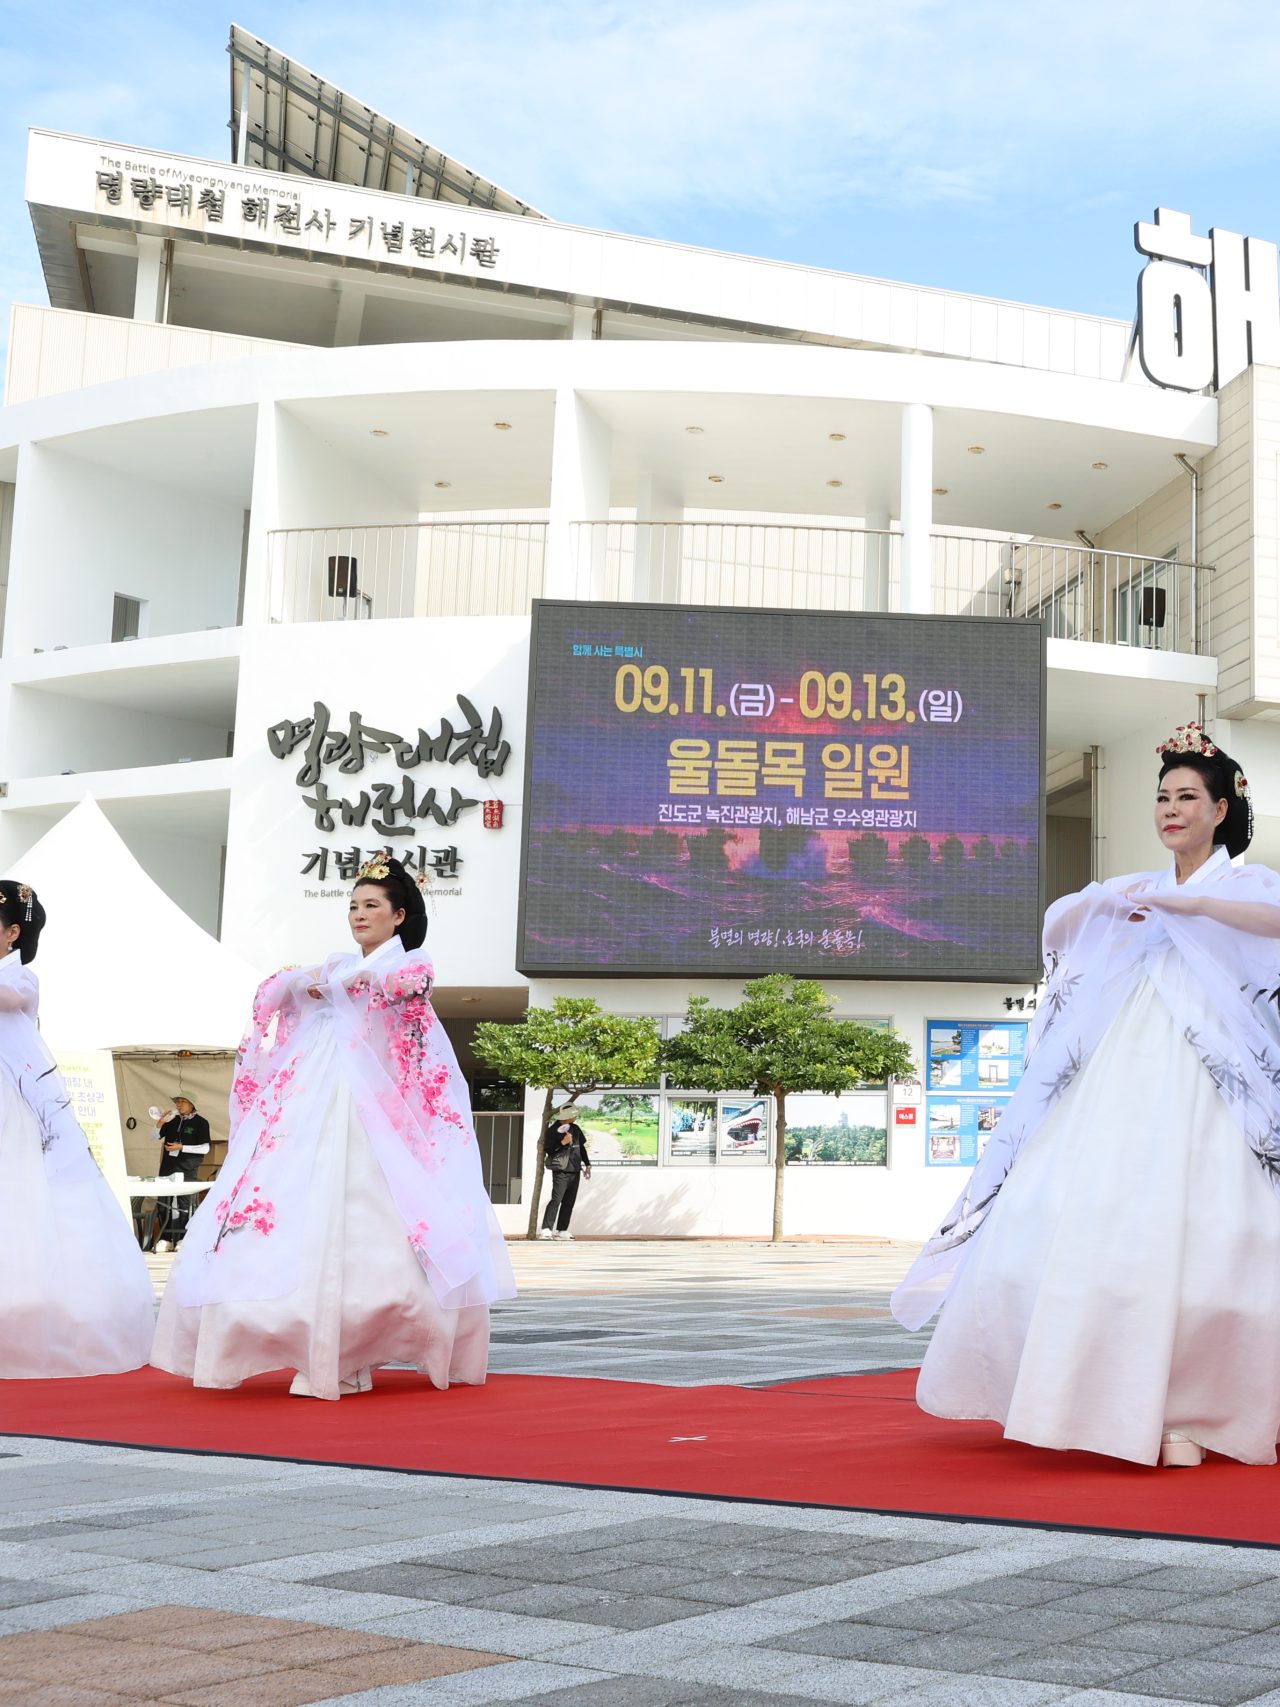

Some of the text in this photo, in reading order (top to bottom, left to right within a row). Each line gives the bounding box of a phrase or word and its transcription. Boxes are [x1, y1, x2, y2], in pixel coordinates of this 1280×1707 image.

[100, 156, 301, 201] The Battle of Myeongnyang Memorial
[96, 171, 500, 268] 명량대첩 해전사 기념전시관
[593, 645, 613, 657] 사는
[267, 693, 511, 788] 명량대첩
[666, 738, 911, 801] 울돌목 일원
[302, 775, 480, 837] 해전사
[658, 804, 918, 829] 진도군 녹진관광지, 해남군 우수영관광지
[303, 889, 319, 898] The
[320, 889, 345, 898] Battle
[708, 927, 744, 949] 불멸의
[748, 928, 781, 948] 명량!
